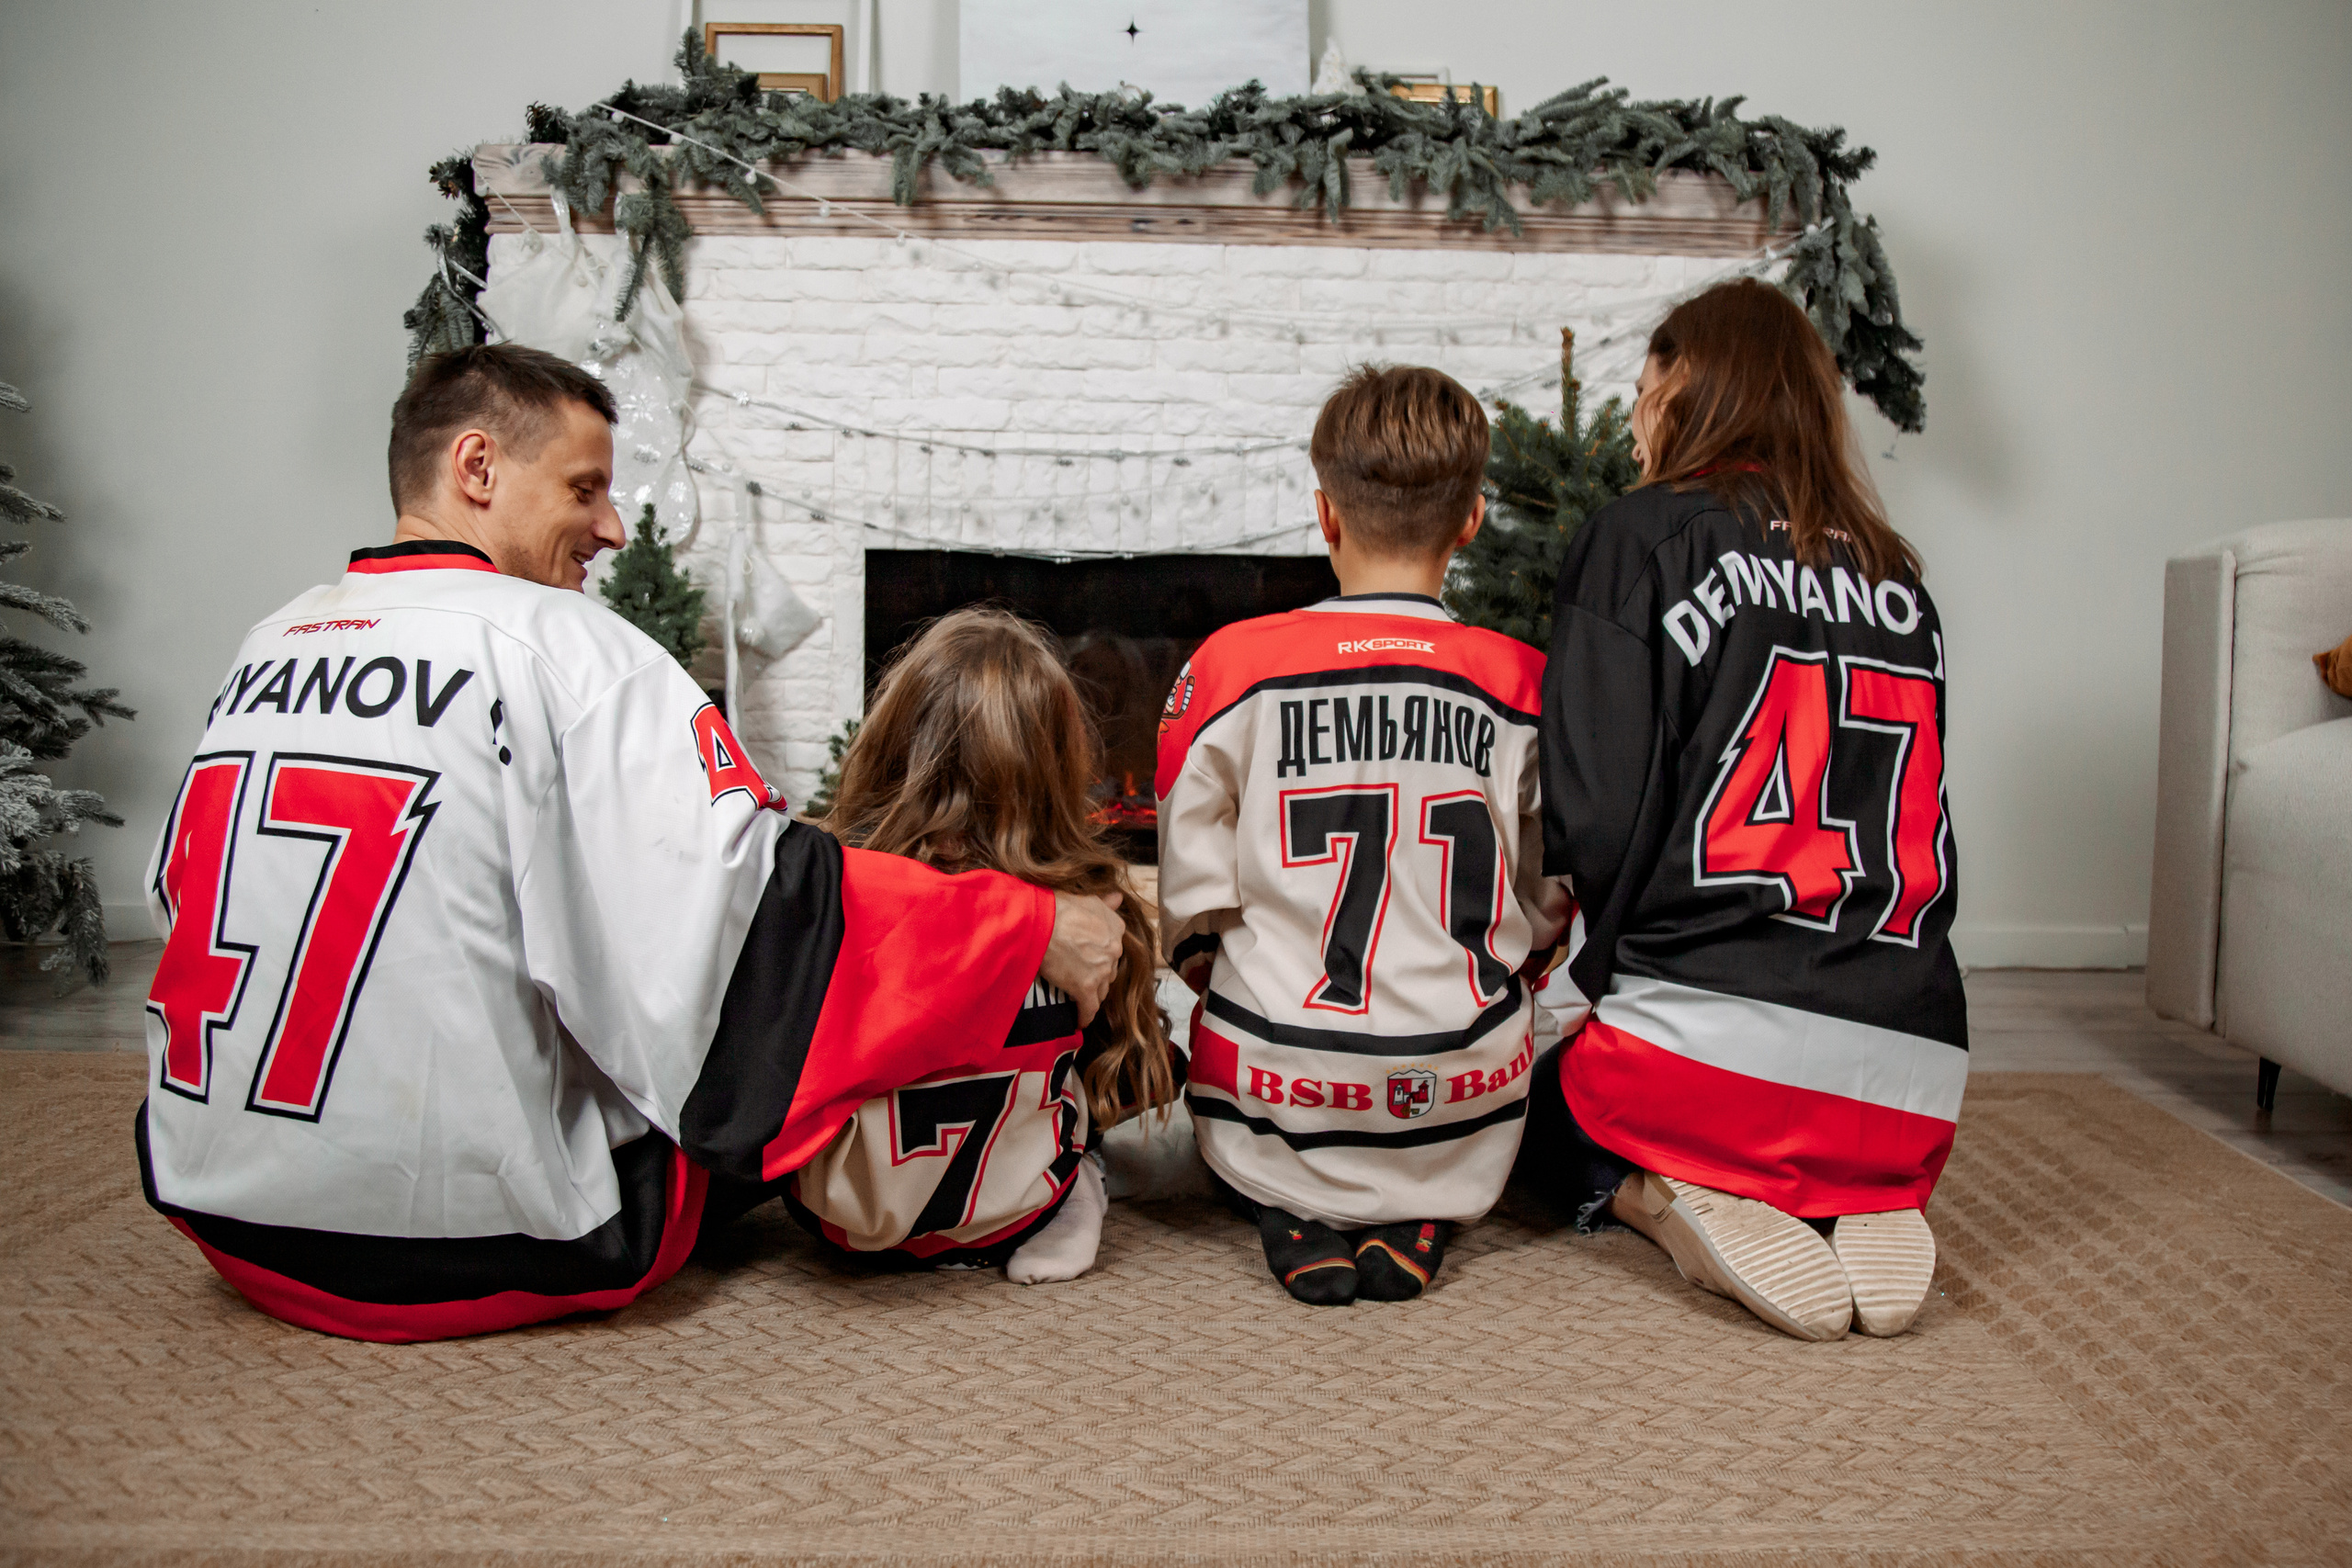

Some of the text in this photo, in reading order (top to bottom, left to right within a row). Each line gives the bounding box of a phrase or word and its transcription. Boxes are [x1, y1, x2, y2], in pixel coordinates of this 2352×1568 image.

[282, 618, 381, 637] FASTRAN
[1663, 550, 1944, 681] DEMYANO
[1277, 694, 1496, 778] ДЕМЬЯНОВ
[1693, 645, 1949, 948] 47
[145, 750, 442, 1124] 47
[1280, 783, 1514, 1015] 71
[1247, 1065, 1374, 1111] BSB
